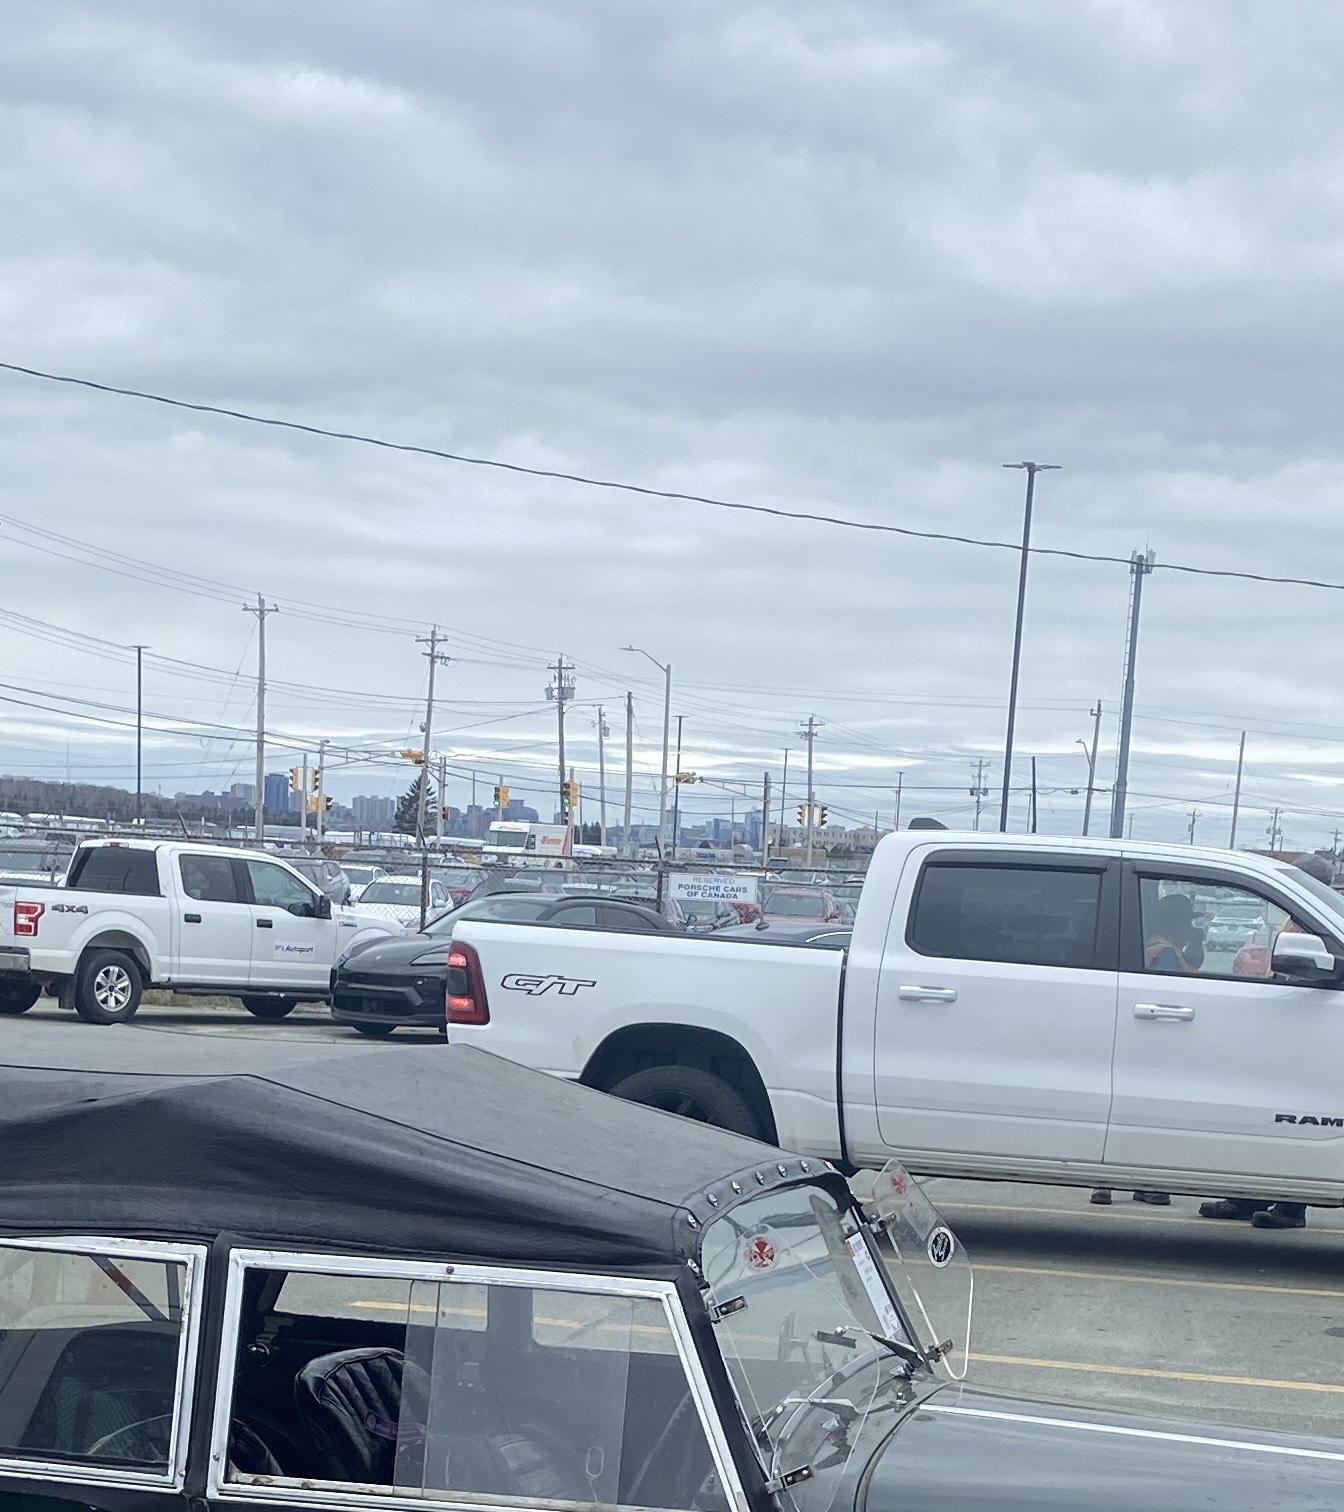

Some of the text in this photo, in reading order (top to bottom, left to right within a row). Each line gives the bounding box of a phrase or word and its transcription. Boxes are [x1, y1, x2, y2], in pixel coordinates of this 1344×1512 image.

[692, 876, 735, 884] RESERVED
[677, 883, 748, 894] PORSCHE CARS
[686, 890, 739, 899] OF CANADA
[1274, 1114, 1344, 1127] RAM
